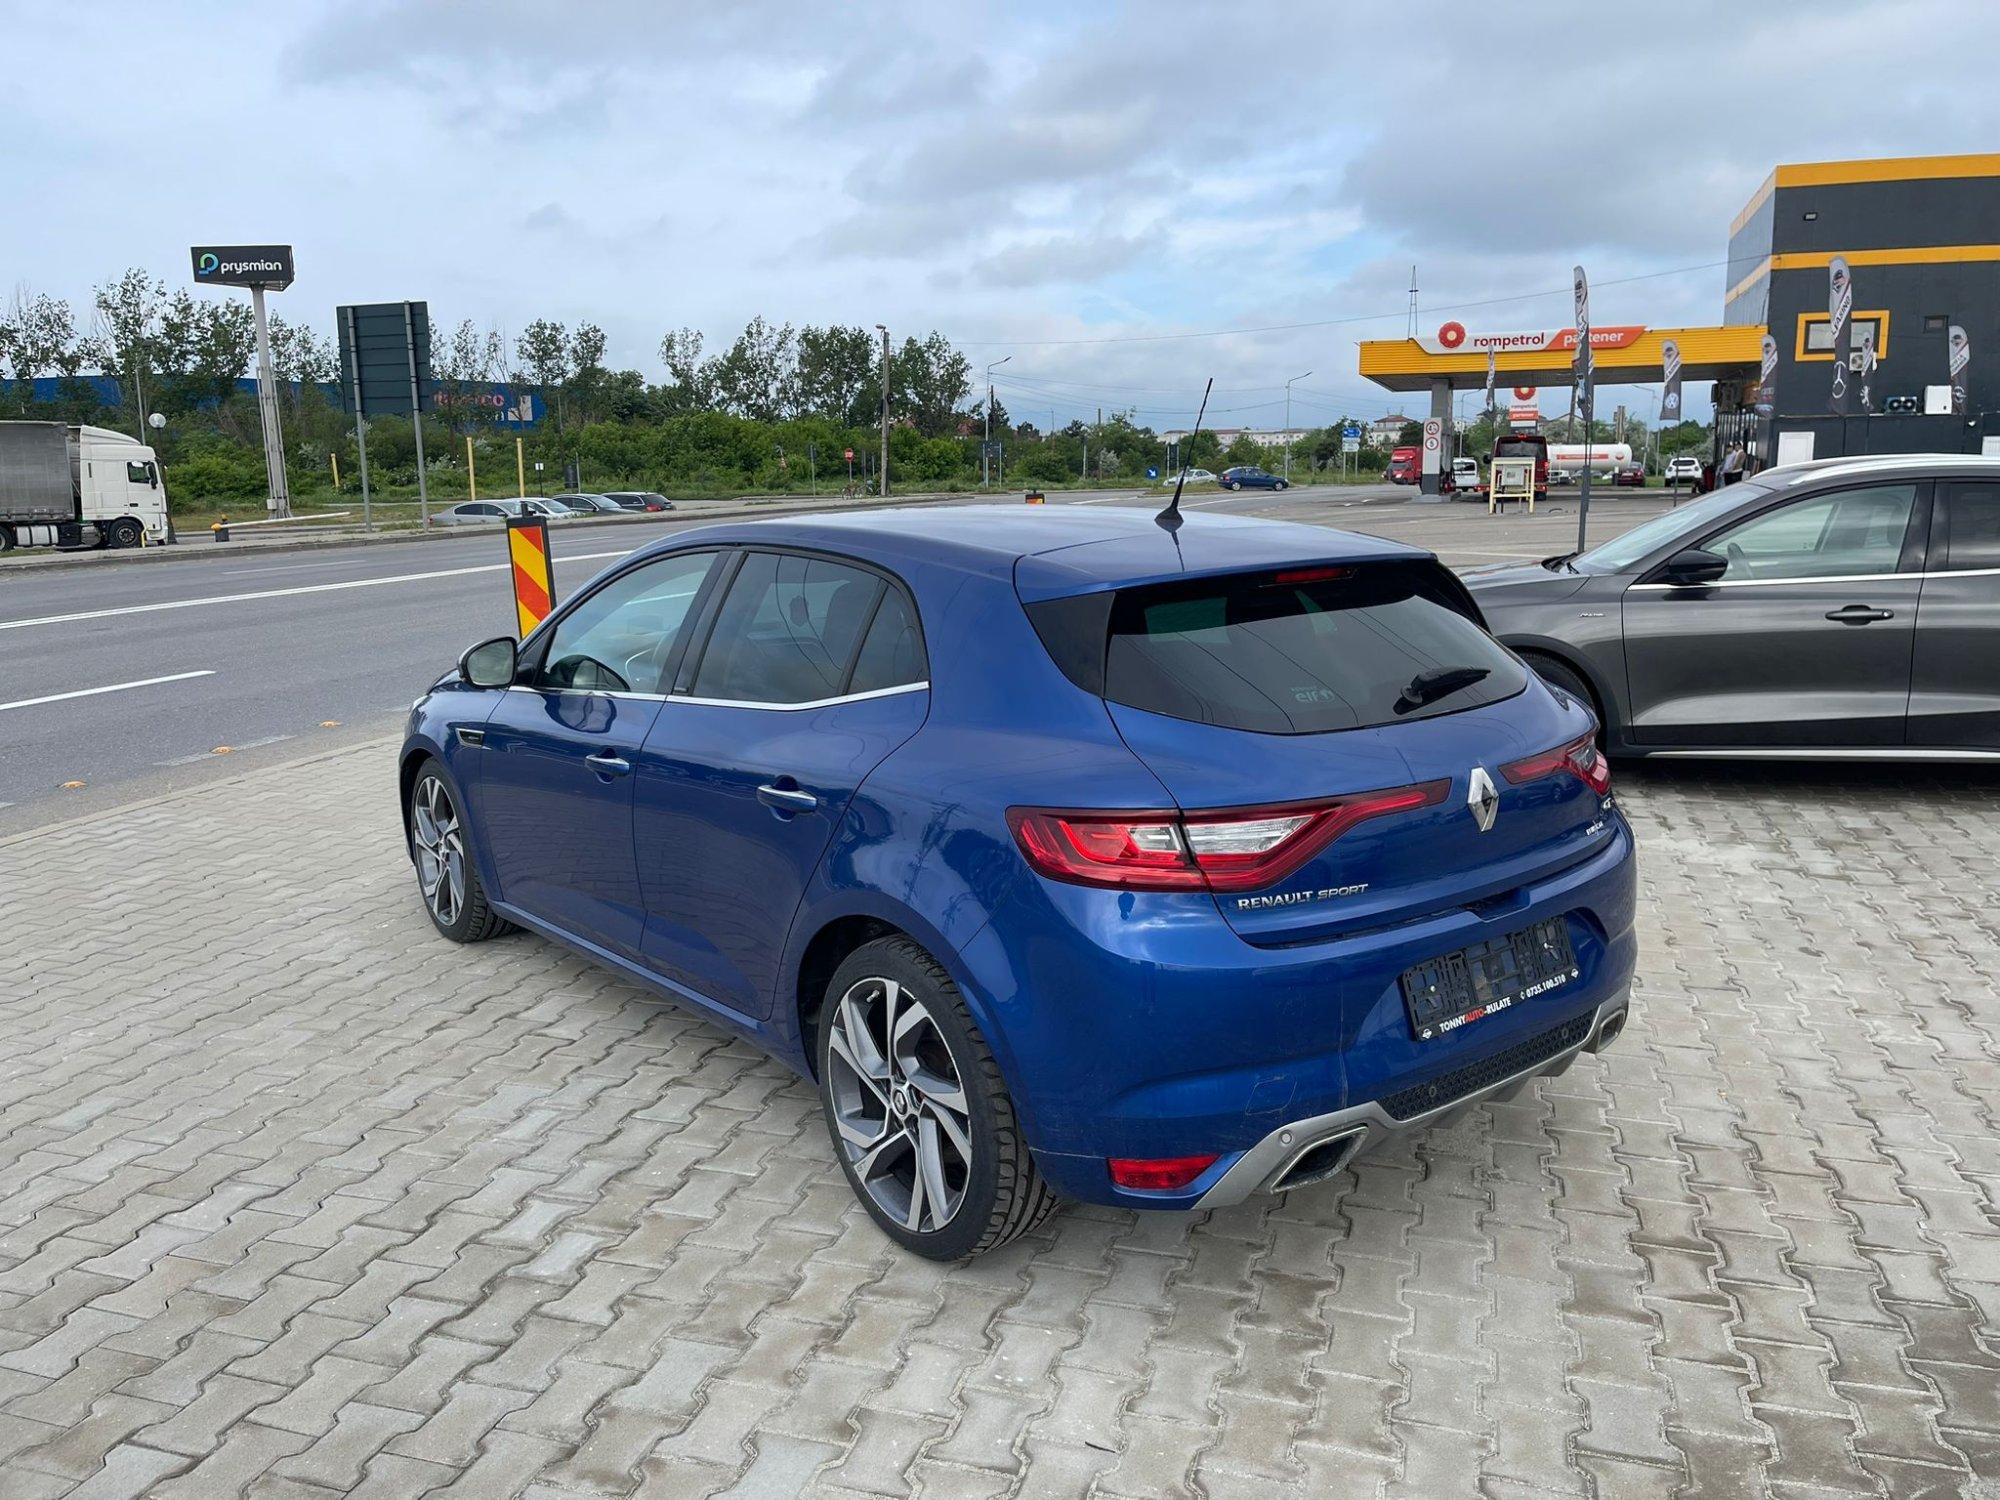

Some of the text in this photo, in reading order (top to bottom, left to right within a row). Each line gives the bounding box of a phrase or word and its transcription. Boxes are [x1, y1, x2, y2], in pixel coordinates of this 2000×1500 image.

[220, 259, 282, 274] prysmian
[1474, 331, 1624, 349] rompetrol patener
[1237, 883, 1369, 910] RENAULT SPORT
